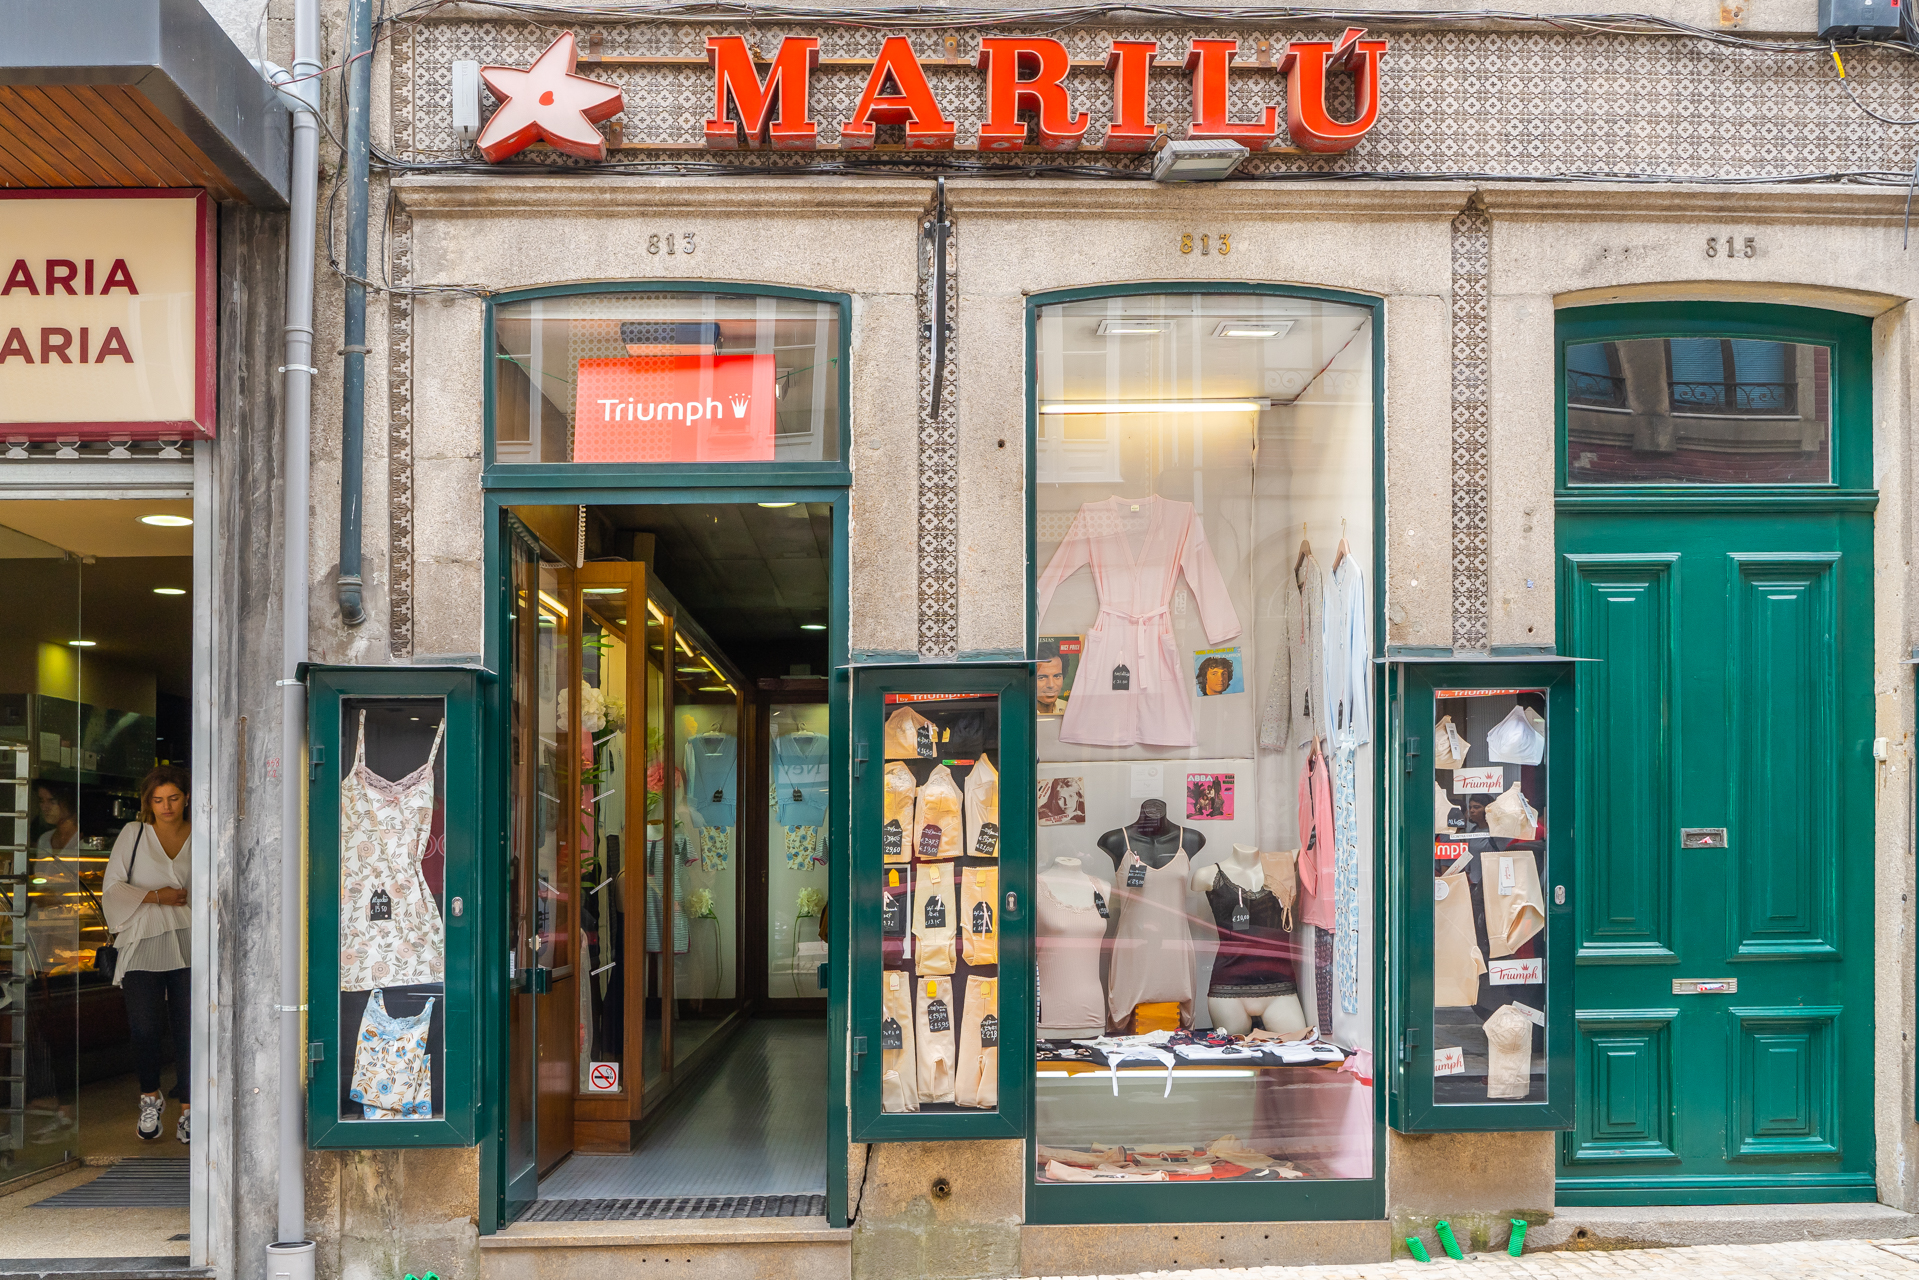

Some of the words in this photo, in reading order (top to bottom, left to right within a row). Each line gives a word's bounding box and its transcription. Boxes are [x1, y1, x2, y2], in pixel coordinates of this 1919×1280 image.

[706, 27, 1388, 153] MARILÚ
[647, 232, 696, 255] 813
[1180, 233, 1231, 255] 813
[1706, 237, 1756, 257] 815
[0, 258, 139, 296] ARIA
[0, 327, 134, 364] ARIA
[597, 397, 723, 426] Triumph
[1187, 774, 1213, 782] ABBA
[1453, 774, 1503, 793] Triumph
[1490, 965, 1539, 985] Triumph
